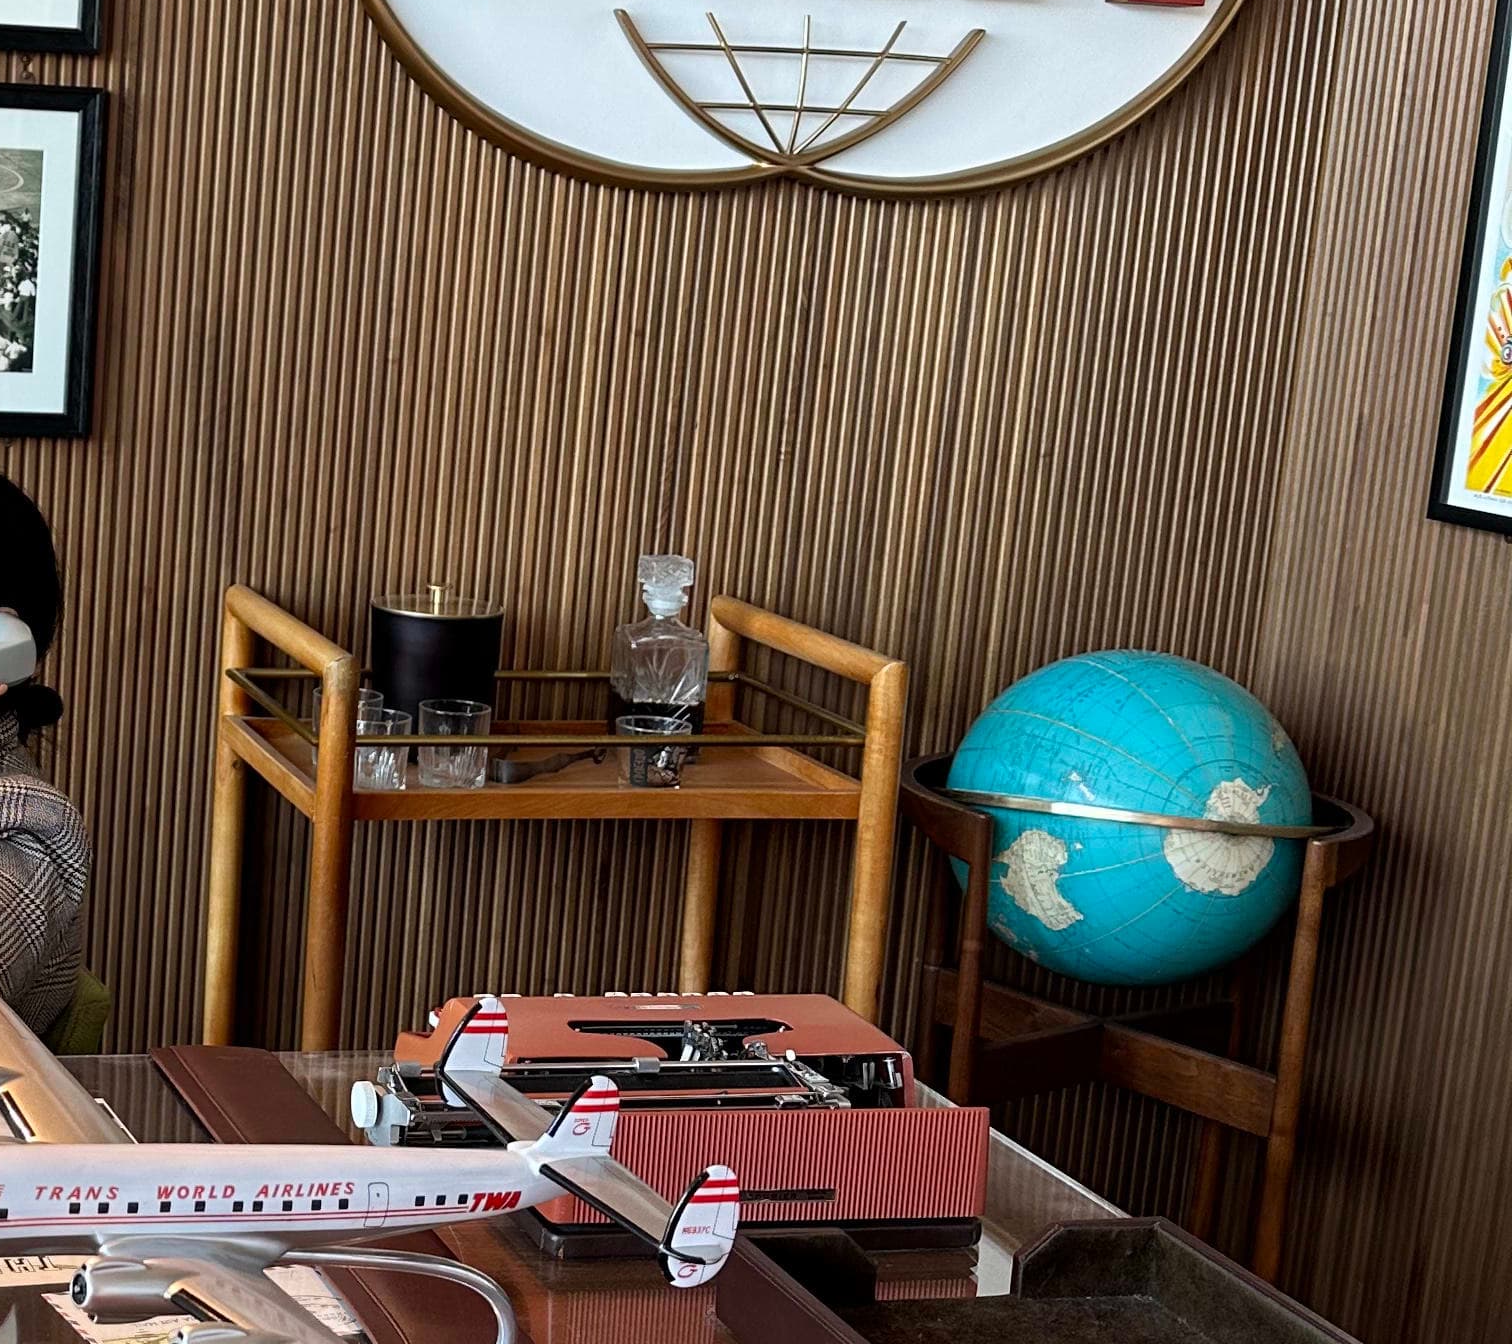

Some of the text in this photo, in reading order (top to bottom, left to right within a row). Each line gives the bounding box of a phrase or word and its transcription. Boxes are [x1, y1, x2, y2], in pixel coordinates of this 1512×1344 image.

[34, 1182, 355, 1200] TRANS WORLD AIRLINES
[469, 1190, 522, 1213] TWA
